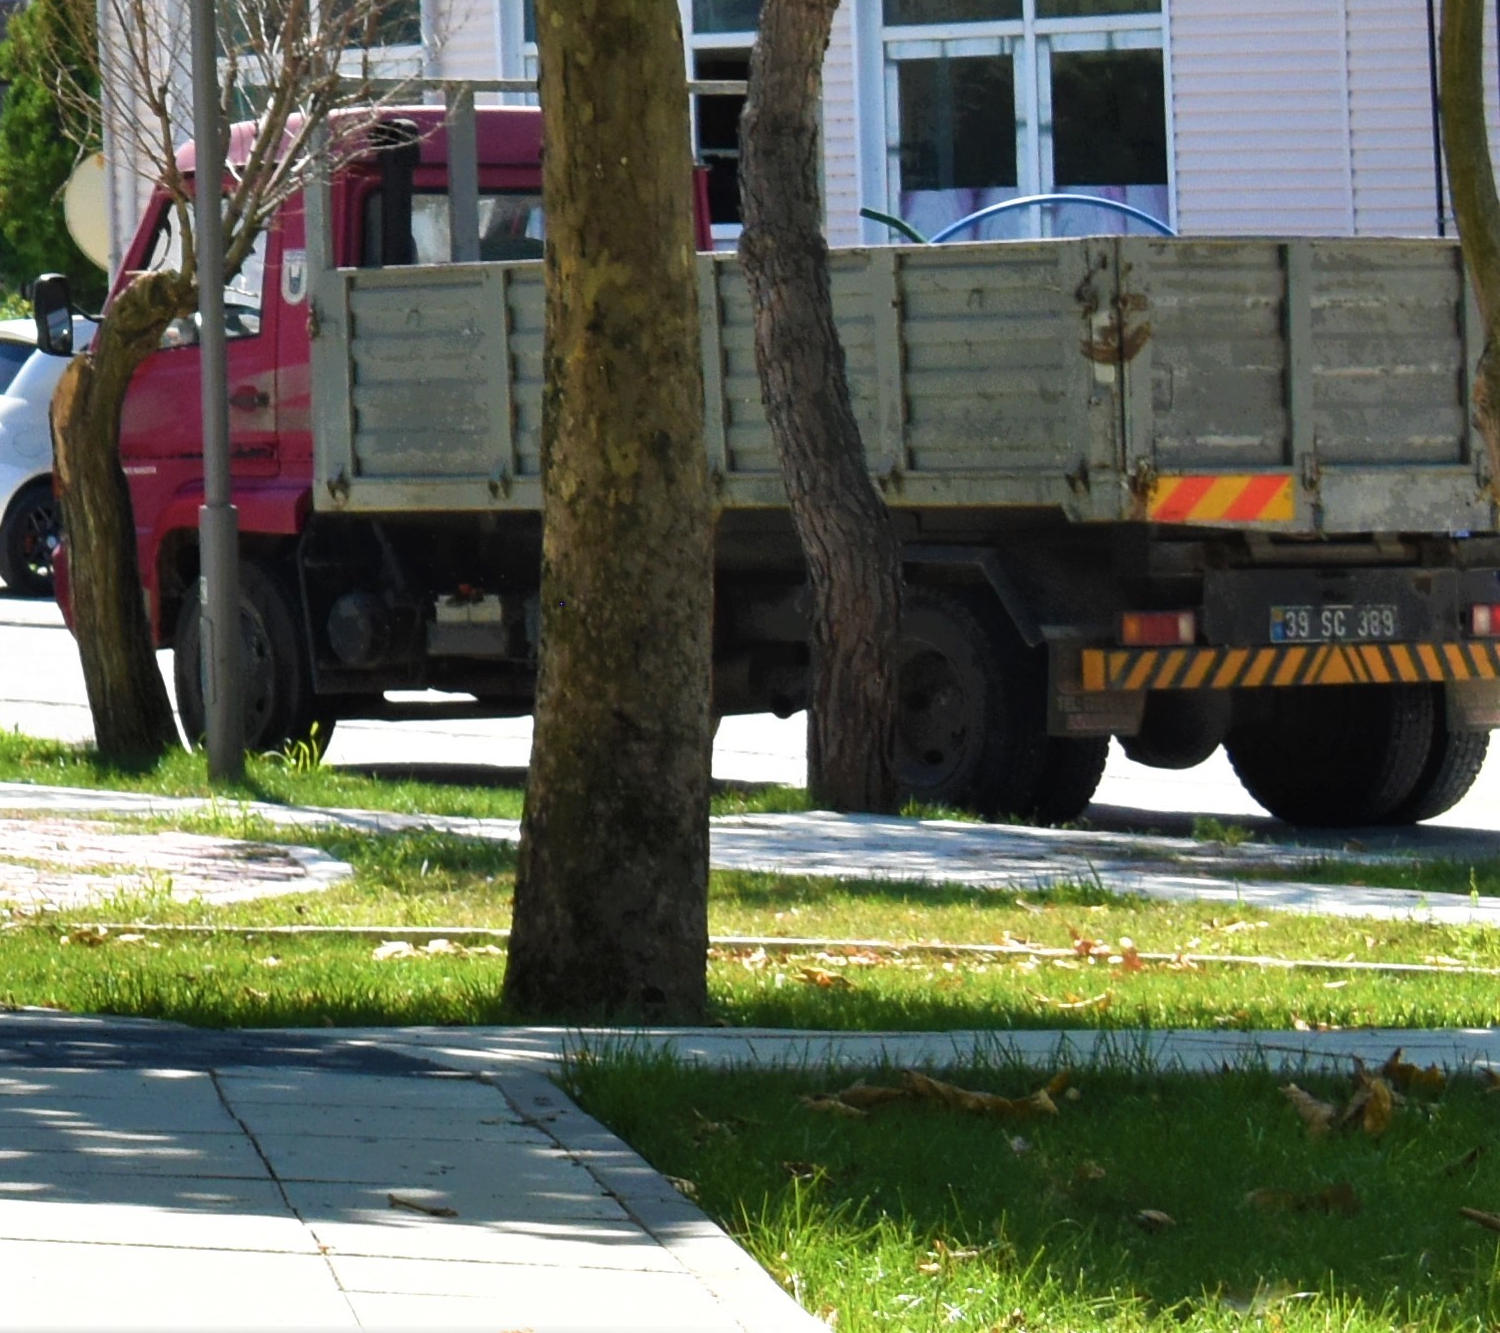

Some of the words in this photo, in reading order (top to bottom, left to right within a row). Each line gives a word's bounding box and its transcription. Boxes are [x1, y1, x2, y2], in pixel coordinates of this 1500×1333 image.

[1284, 611, 1309, 637] 39
[1321, 610, 1346, 637] SC
[1357, 610, 1394, 637] 389
